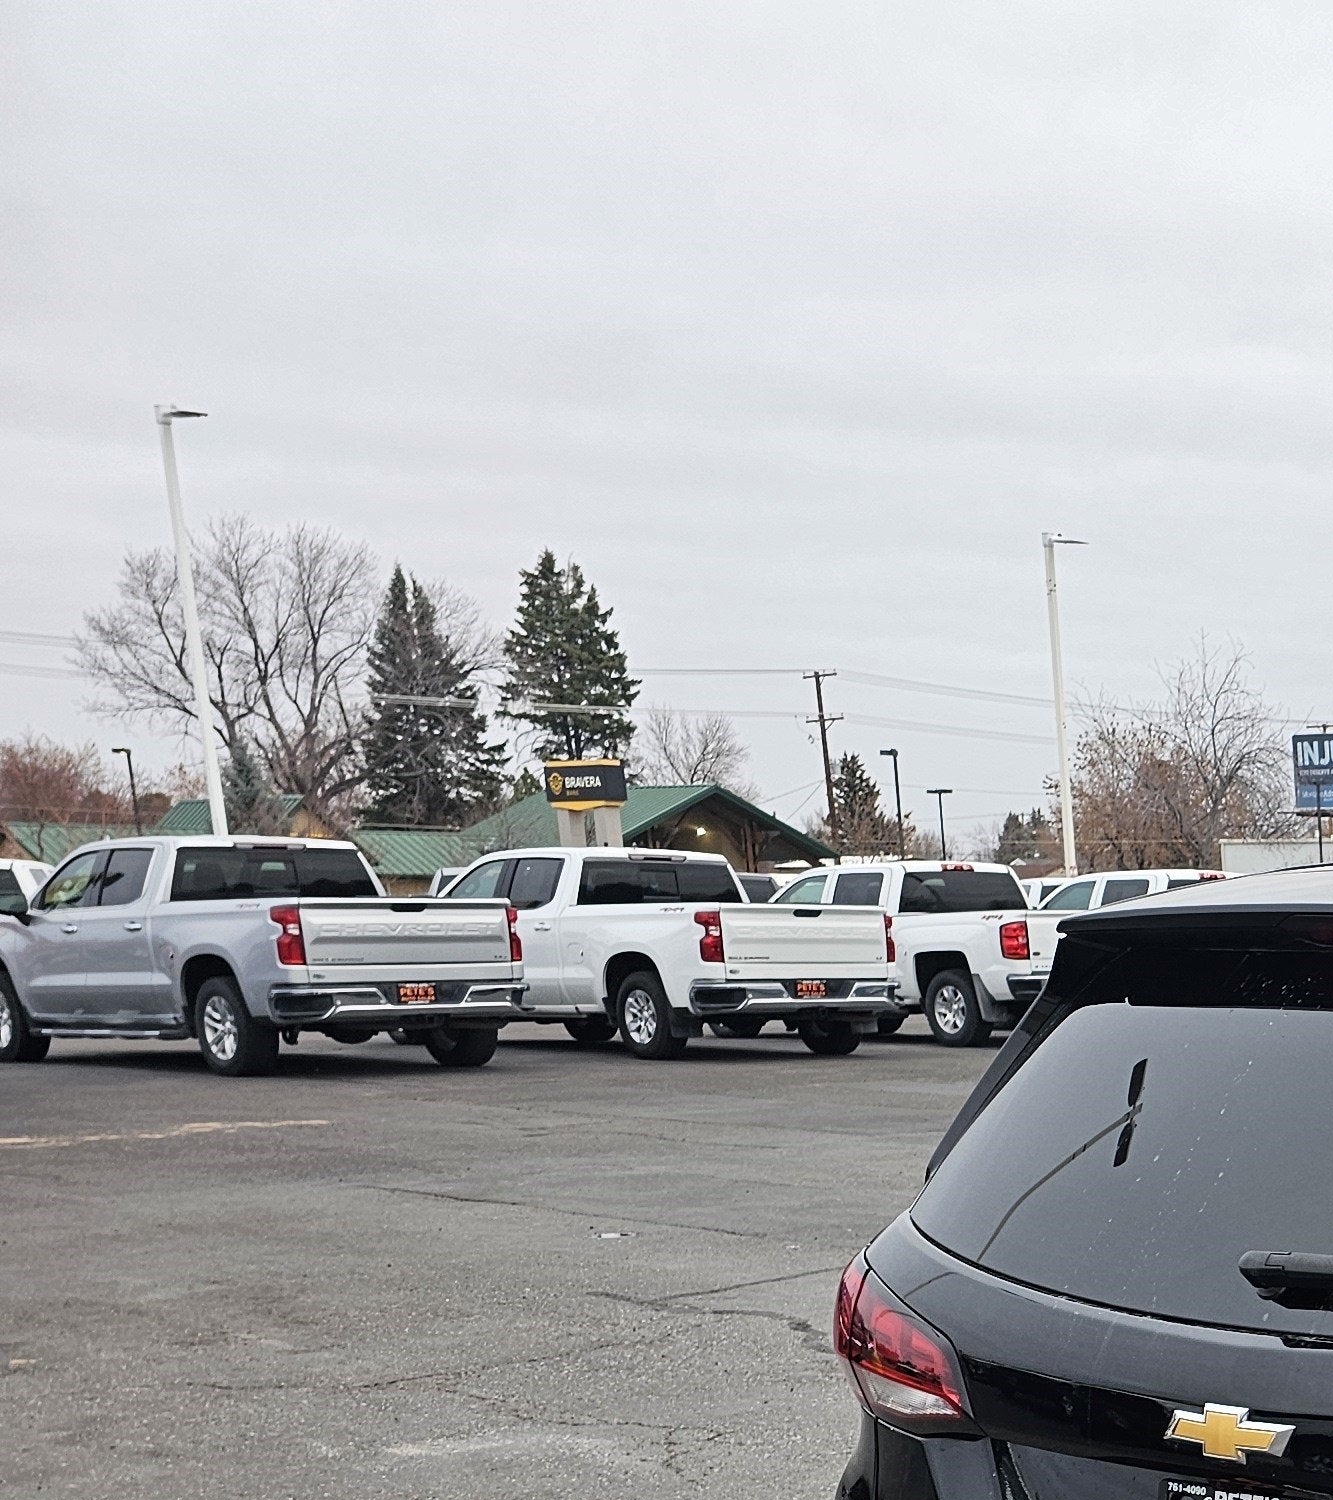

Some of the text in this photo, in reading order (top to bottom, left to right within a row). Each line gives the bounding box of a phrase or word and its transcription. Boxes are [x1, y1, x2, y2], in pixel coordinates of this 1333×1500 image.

[565, 776, 601, 788] BRAVERA
[320, 922, 497, 936] CHEVROLET
[1167, 1482, 1206, 1495] 761-4090
